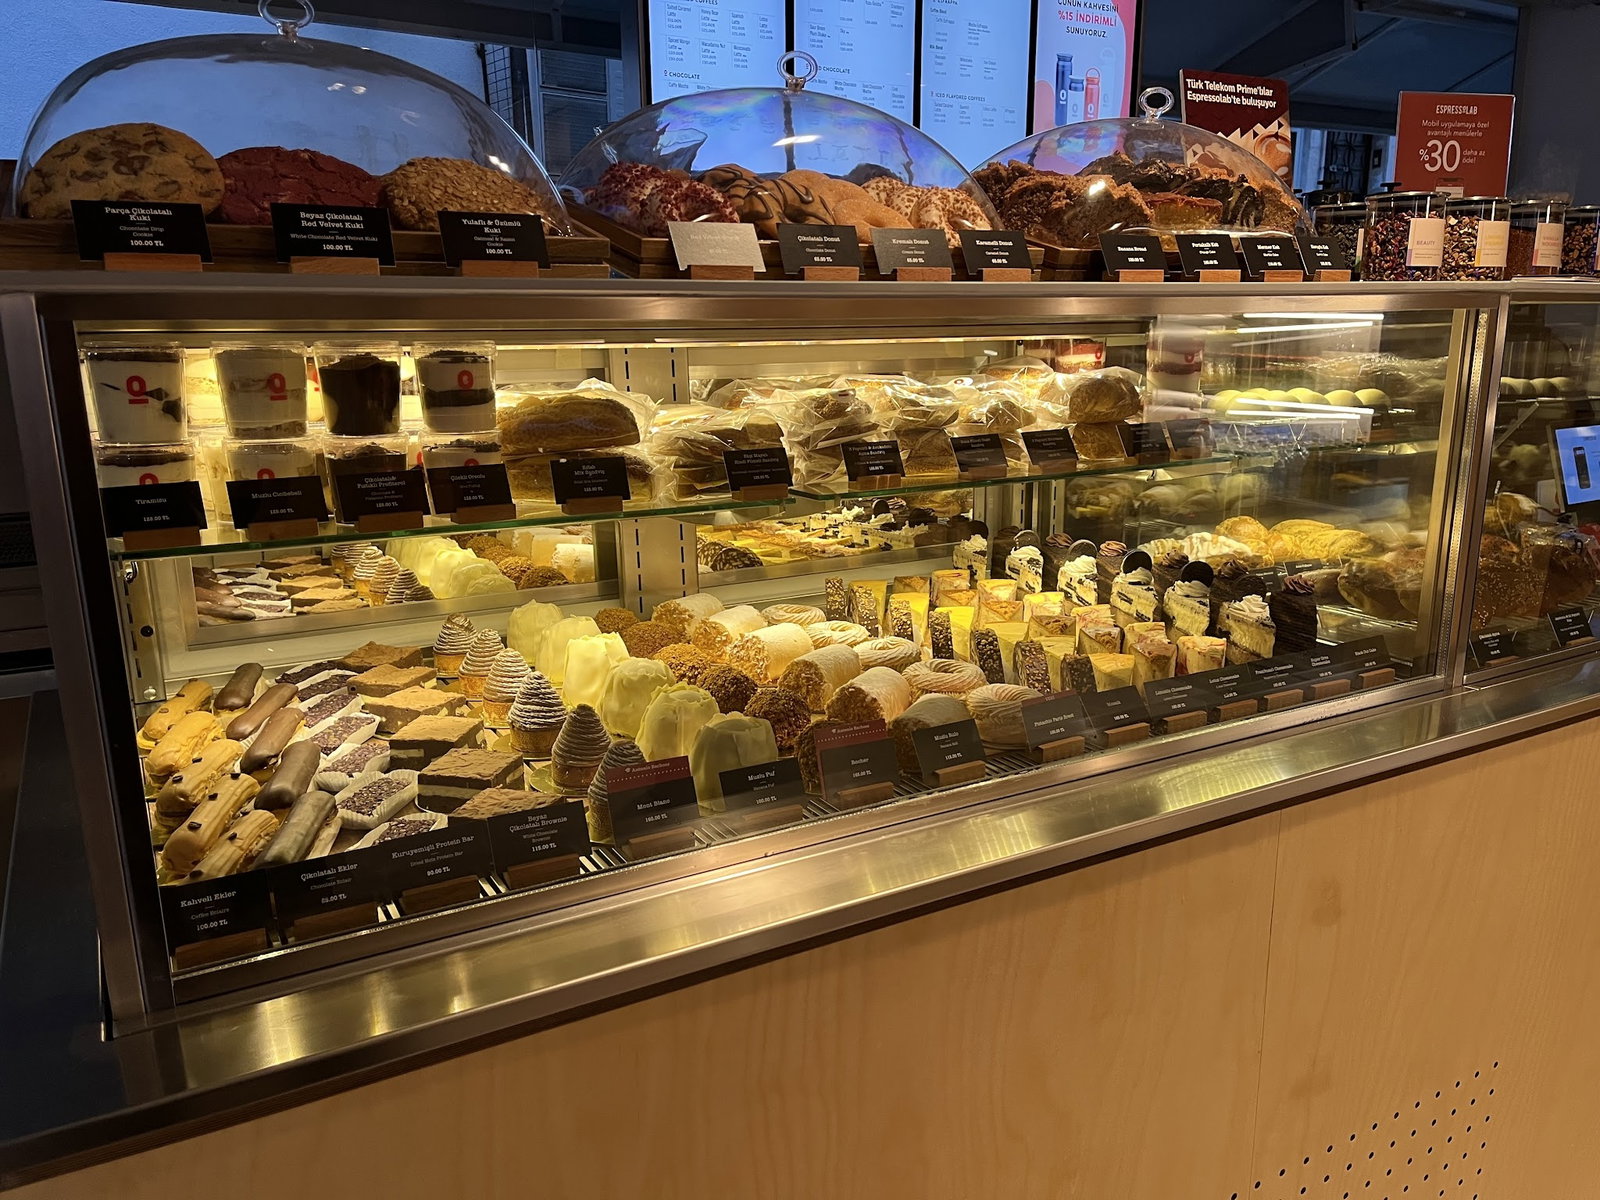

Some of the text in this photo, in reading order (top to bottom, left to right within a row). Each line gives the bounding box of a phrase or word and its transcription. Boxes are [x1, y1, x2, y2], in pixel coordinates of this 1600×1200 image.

[1084, 1, 1119, 13] KAHVESİNİ
[1058, 10, 1117, 27] %15 İNDİRİMLİ
[823, 66, 850, 74] CHOCOLATE
[1186, 79, 1204, 90] Türk
[1204, 81, 1236, 93] Telekom
[1187, 91, 1277, 109] Espressolab'te buluşuyor
[1436, 105, 1478, 115] ESPRESSOLAB
[105, 207, 173, 216] Parça Çikolatalı
[300, 212, 363, 222] Beyaz Çikolatalı
[136, 497, 168, 505] Tiramisu
[637, 801, 653, 811] Mont
[528, 814, 548, 823] Beyaz
[509, 816, 568, 833] Çikolatalı Brownie
[392, 845, 435, 860] Kuruyemişli
[436, 838, 461, 850] Protein
[301, 863, 358, 882] Çikolatalı Ekler
[180, 890, 237, 908] Kahveli Ekler
[197, 921, 218, 931] 100.00
